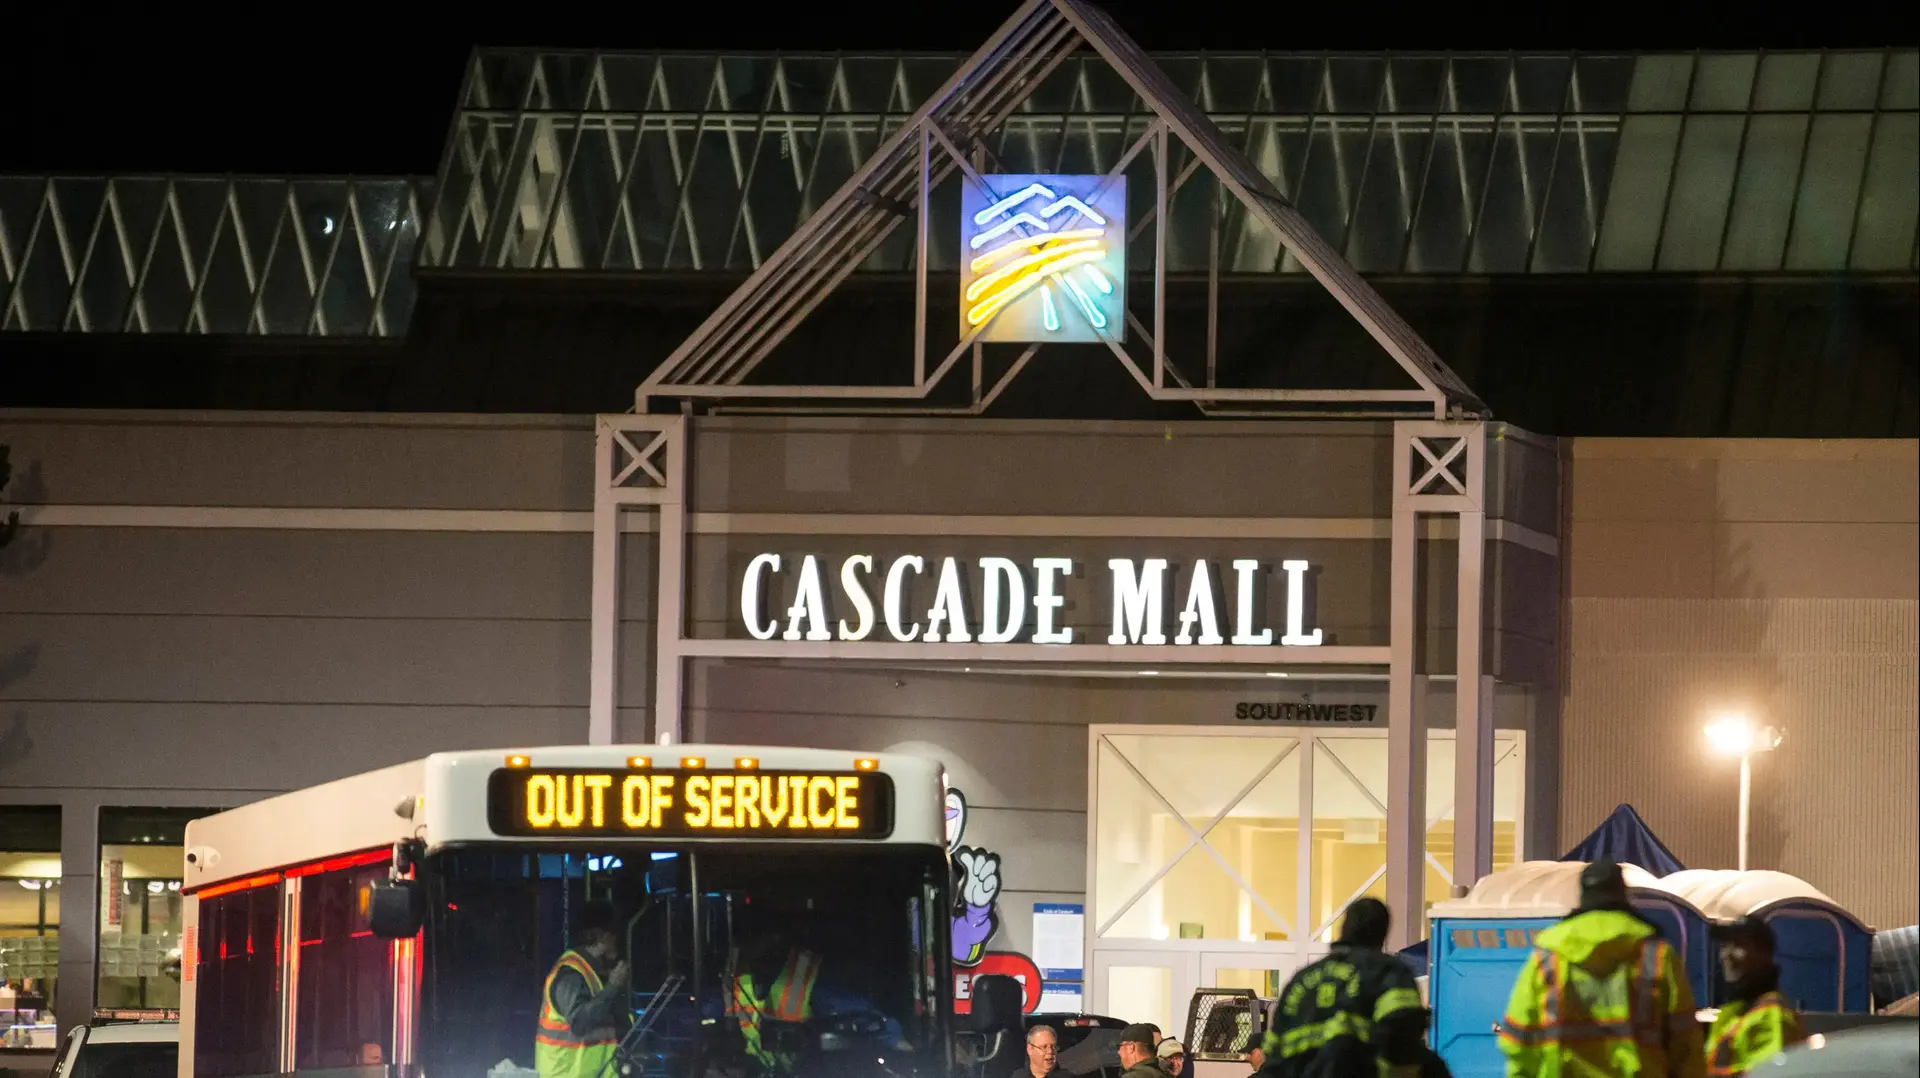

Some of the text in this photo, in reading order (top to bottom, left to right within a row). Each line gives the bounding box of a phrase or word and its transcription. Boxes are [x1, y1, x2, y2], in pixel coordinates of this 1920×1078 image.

[741, 553, 1323, 646] CASCADE MALL
[1235, 702, 1378, 721] SOUTHWEST
[526, 774, 860, 829] OUT OF SERVICE
